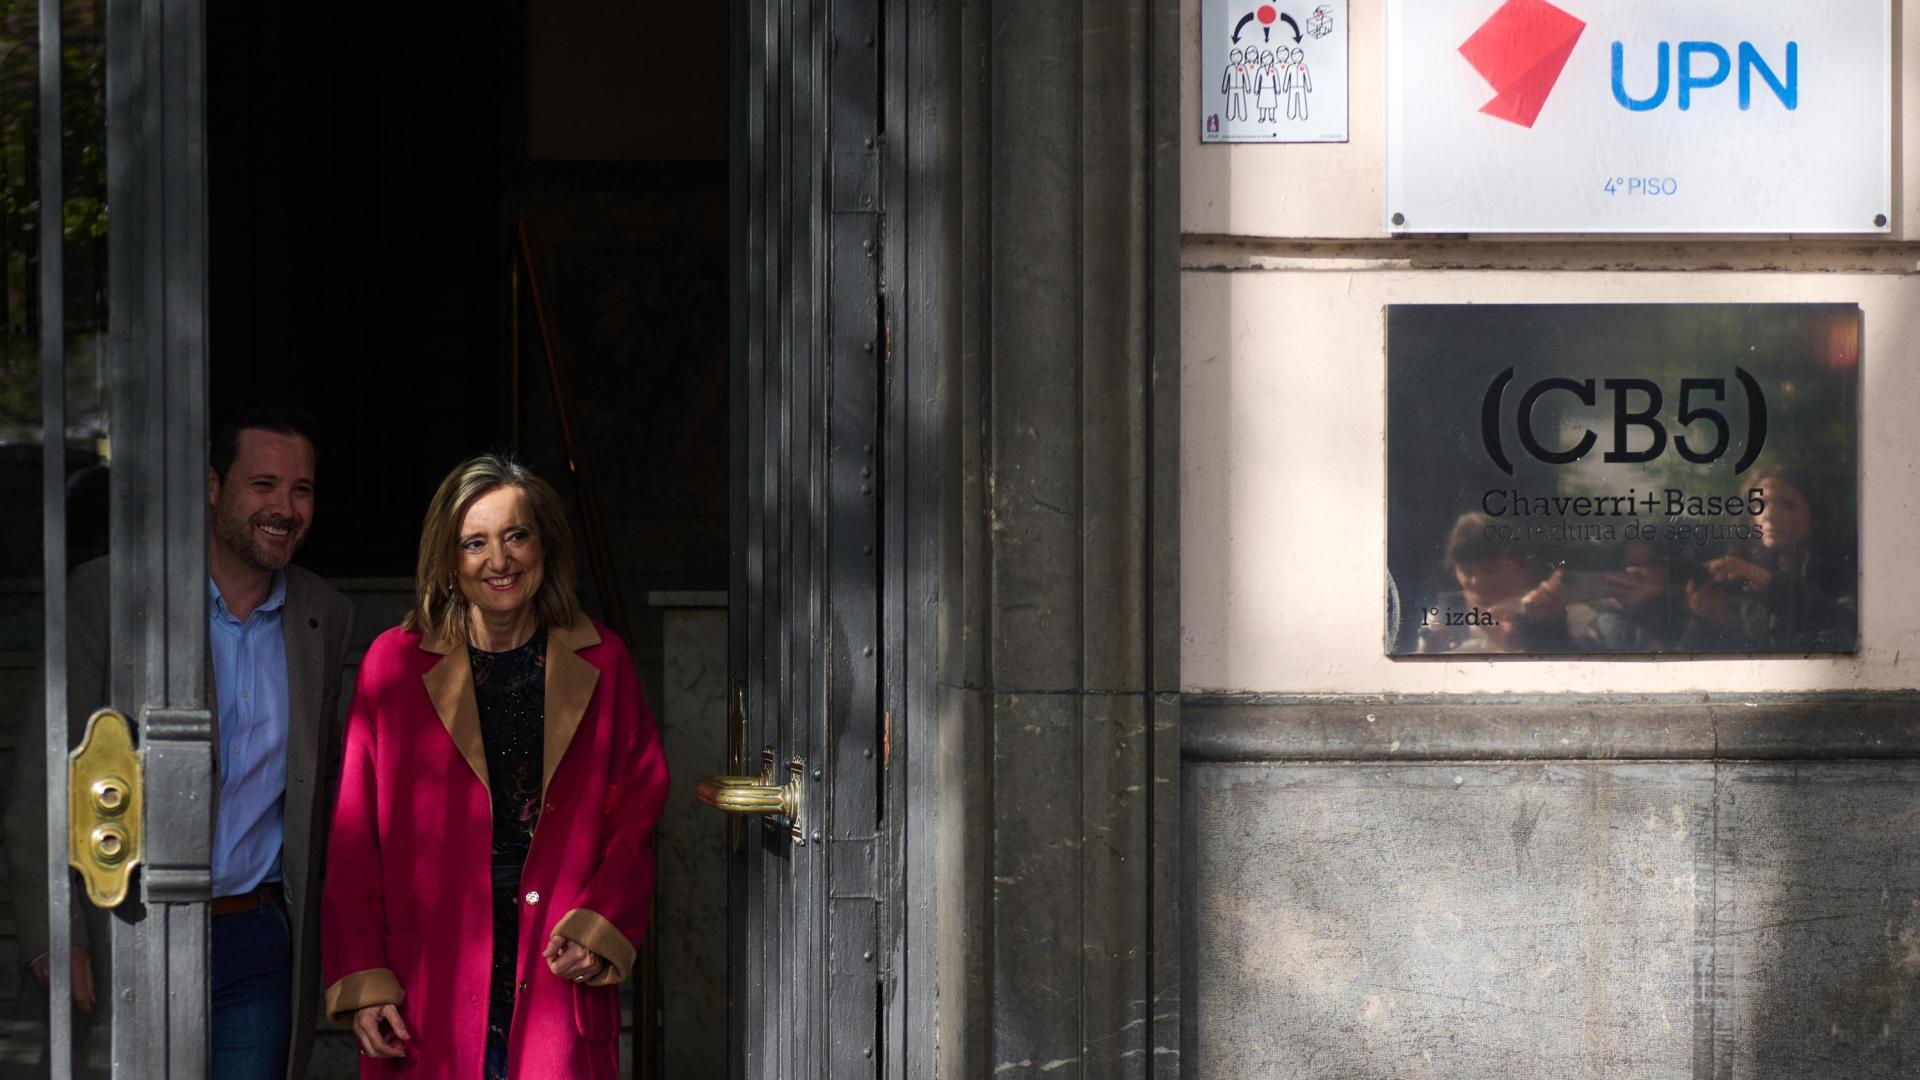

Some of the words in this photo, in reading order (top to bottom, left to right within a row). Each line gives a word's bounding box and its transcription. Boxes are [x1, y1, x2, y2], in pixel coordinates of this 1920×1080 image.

[1610, 40, 1798, 112] UPN
[1628, 177, 1678, 195] PISO
[1481, 366, 1768, 476] (CB5)
[1482, 488, 1765, 517] Chaverri+Base5
[1624, 519, 1657, 541] de
[1663, 523, 1764, 545] seguros
[1445, 607, 1500, 626] izda.
